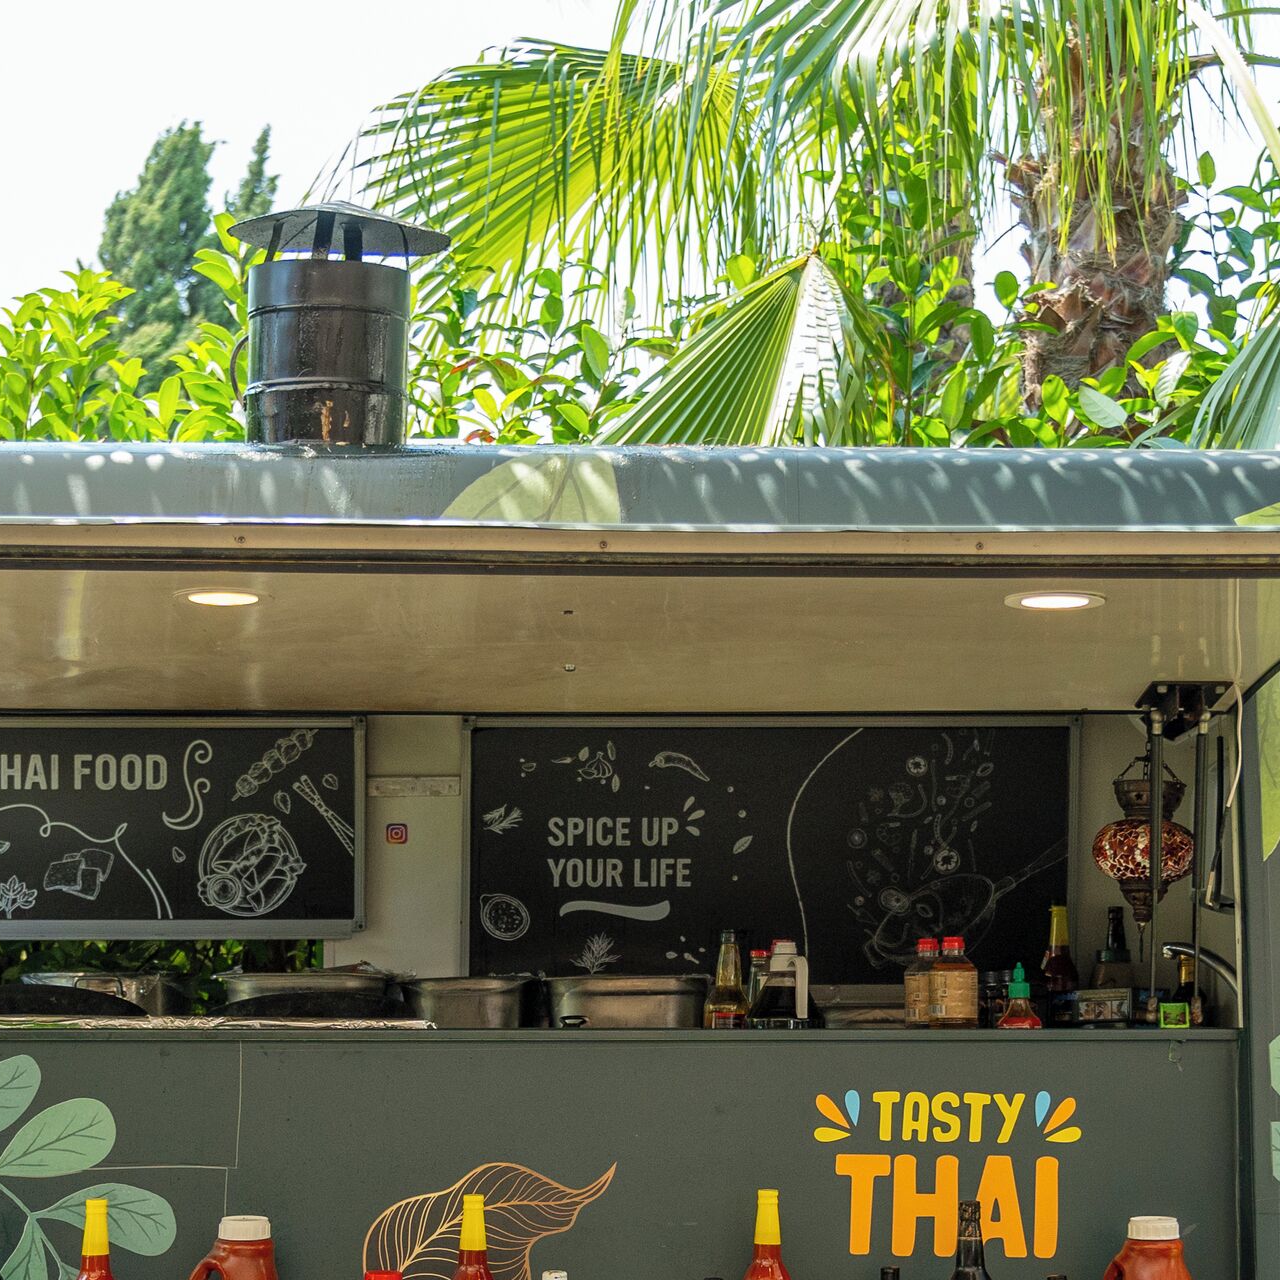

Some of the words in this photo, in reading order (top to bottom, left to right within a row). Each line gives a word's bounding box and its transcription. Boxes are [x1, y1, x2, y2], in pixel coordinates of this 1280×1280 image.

[73, 753, 168, 791] FOOD
[547, 816, 631, 847] SPICE
[641, 817, 679, 847] UP
[547, 858, 623, 888] YOUR
[633, 858, 692, 888] LIFE
[873, 1090, 1026, 1144] TASTY
[835, 1153, 1059, 1259] THAI
